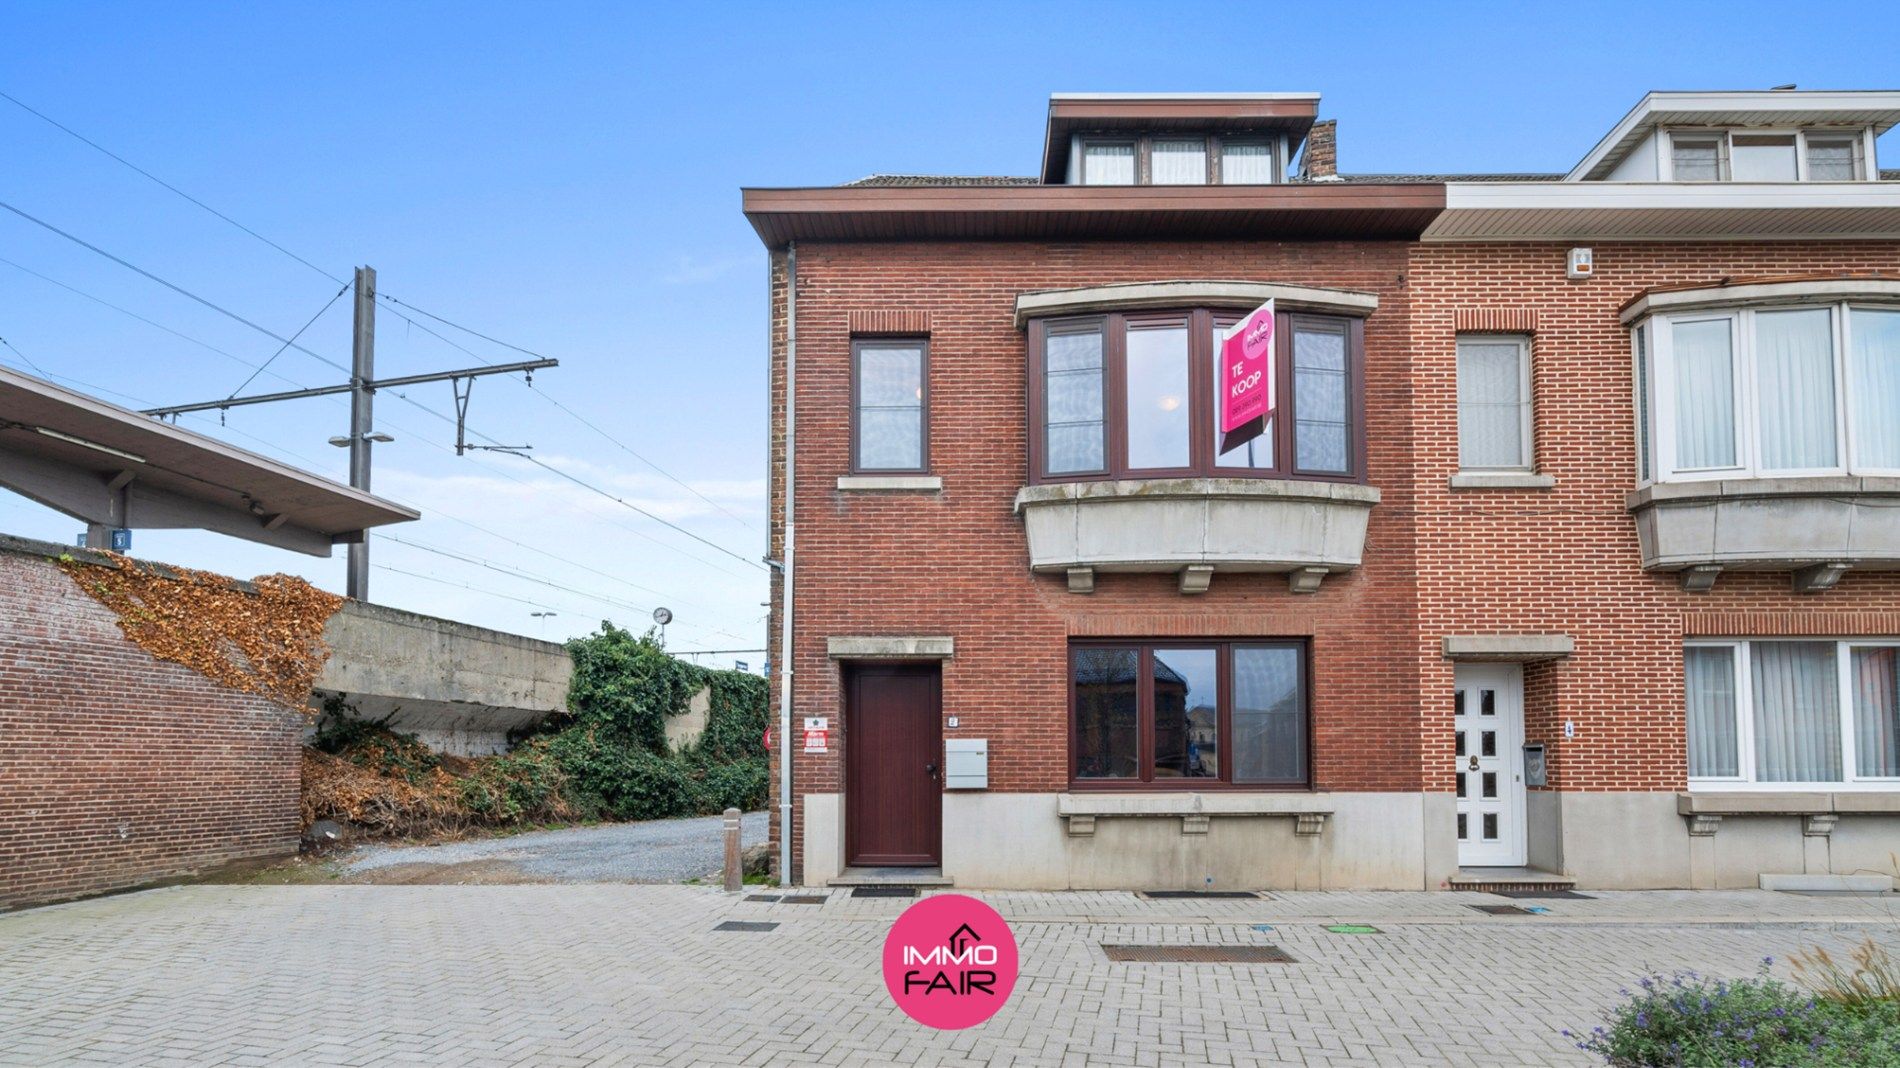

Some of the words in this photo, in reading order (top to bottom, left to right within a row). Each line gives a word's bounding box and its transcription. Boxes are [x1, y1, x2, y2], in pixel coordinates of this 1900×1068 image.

[1247, 331, 1268, 351] FAIR
[1232, 361, 1244, 378] TE
[1232, 371, 1261, 398] KOOP
